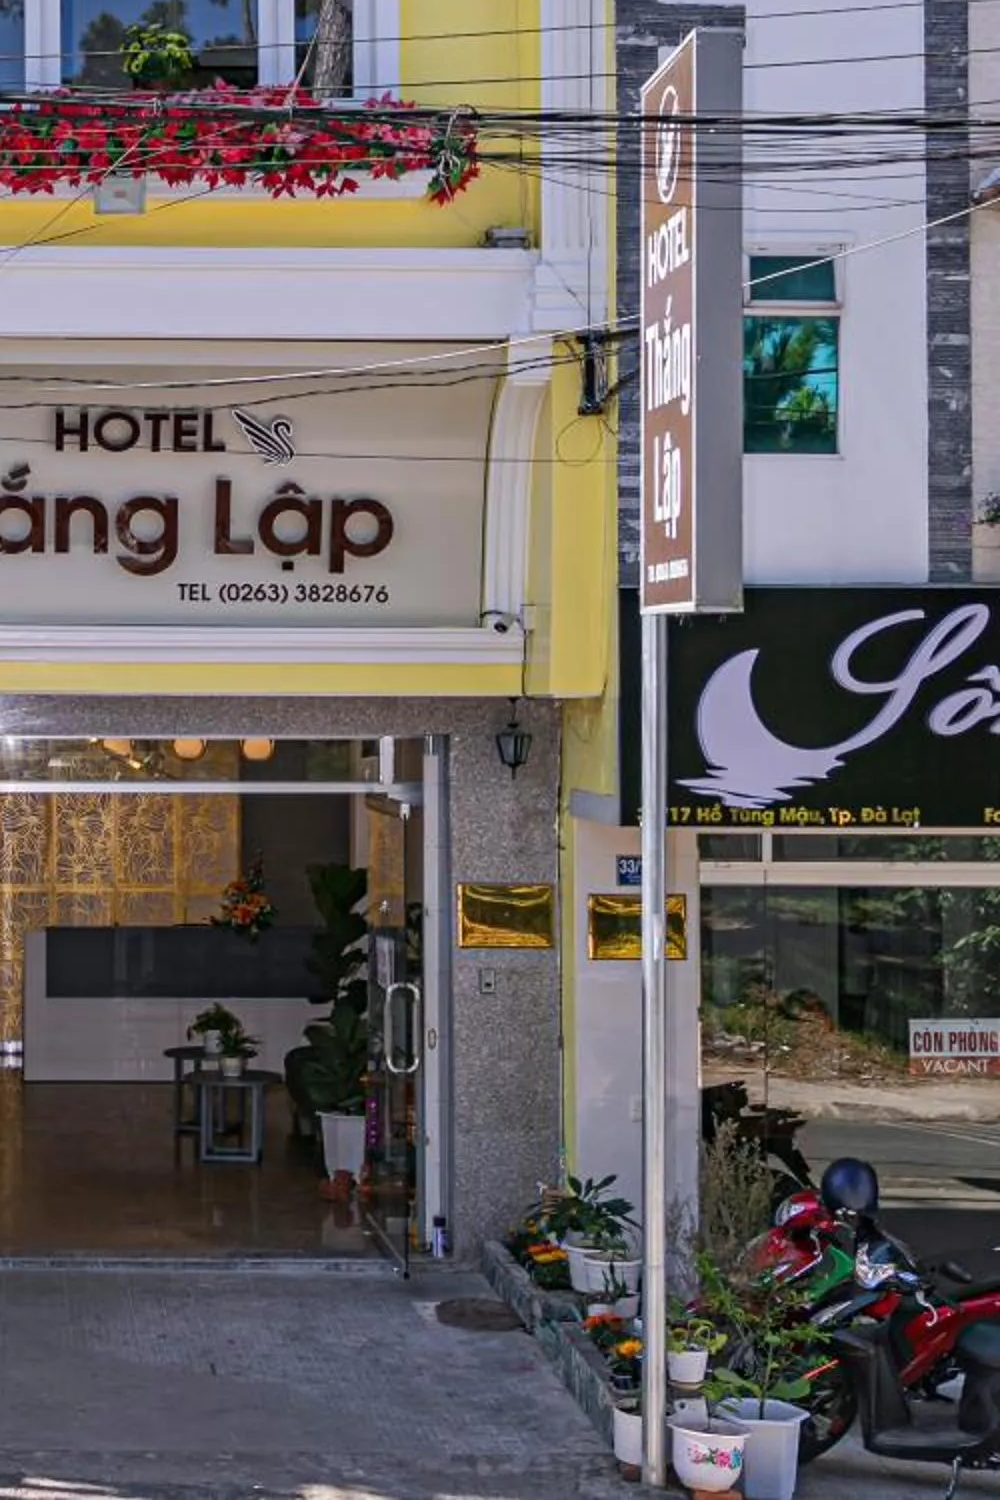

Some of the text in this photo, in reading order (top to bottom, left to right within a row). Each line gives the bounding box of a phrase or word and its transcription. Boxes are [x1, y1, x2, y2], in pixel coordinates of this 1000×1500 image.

[647, 205, 690, 289] HOTEL
[645, 295, 691, 416] Thắng
[55, 408, 226, 453] HOTEL
[654, 431, 682, 540] Lập
[214, 477, 395, 574] Lập
[177, 582, 390, 605] TEL (0263) 3828676
[669, 806, 691, 823] 17
[921, 1058, 989, 1074] VACANT
